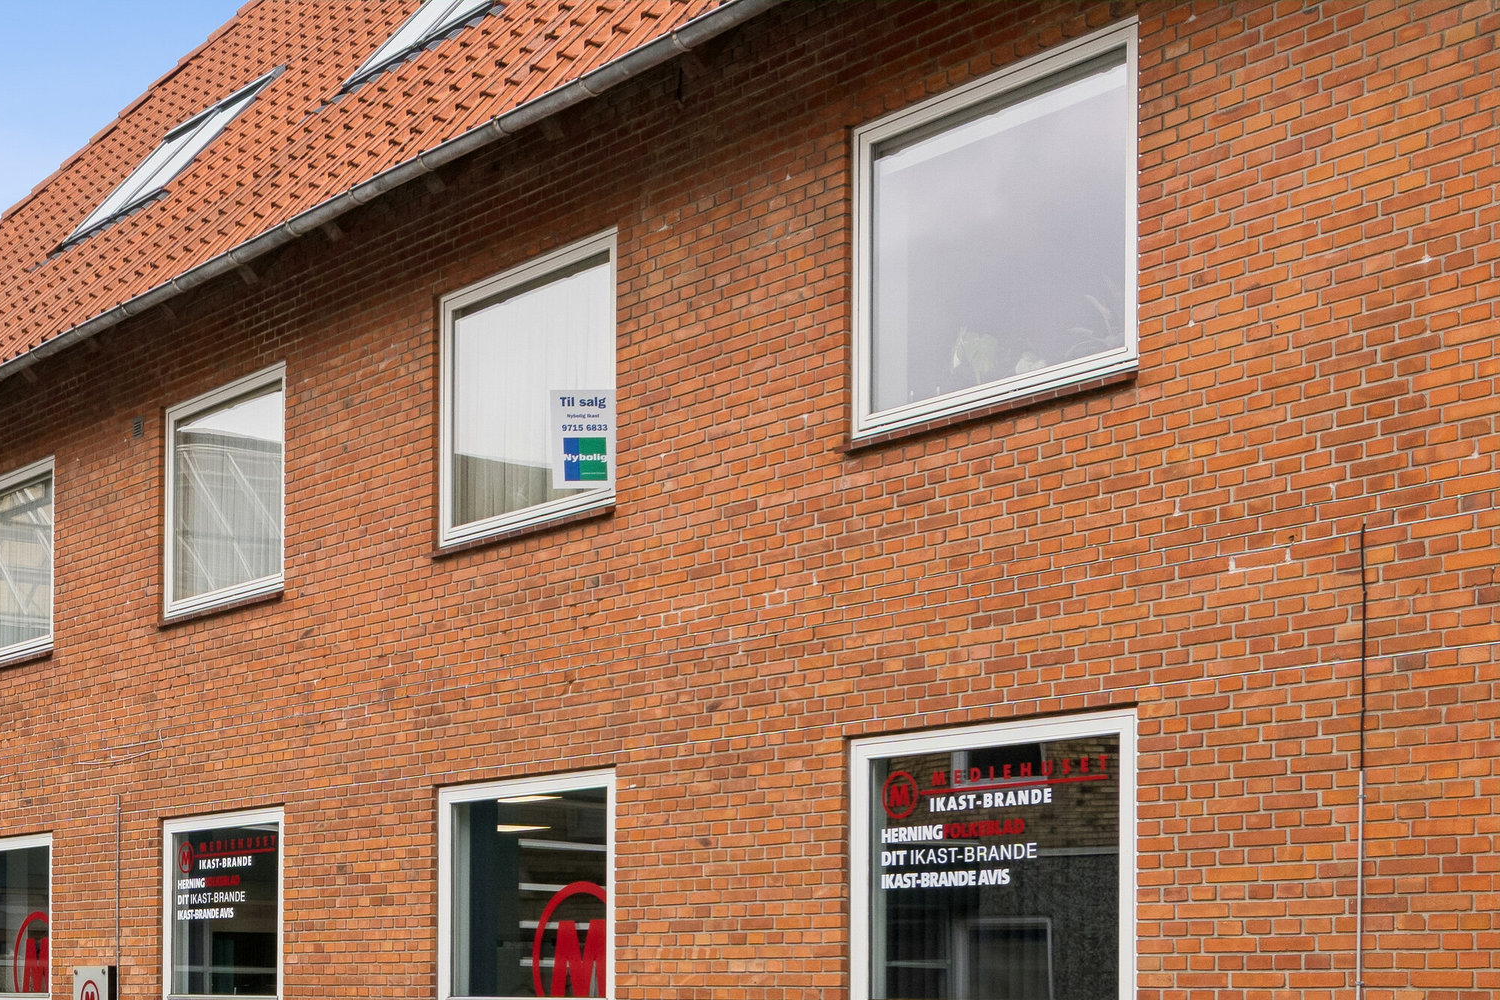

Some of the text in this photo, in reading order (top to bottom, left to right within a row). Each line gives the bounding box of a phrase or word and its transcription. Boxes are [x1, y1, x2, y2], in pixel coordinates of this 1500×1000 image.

[560, 397, 607, 409] Til salg
[564, 453, 607, 463] Nybolig
[931, 755, 1108, 786] MEDIEHUSET
[929, 788, 1052, 812] IKAST-BRANDE
[200, 835, 276, 852] MEDIEHUSET
[881, 842, 1037, 866] DIT IKAST-BRANDE
[199, 856, 252, 870] IKAST-BRANDE
[881, 869, 1011, 889] IKAST-BRANDE AVIS
[178, 891, 245, 905] DIT IKAST-BRANDE
[178, 907, 234, 920] IKAST-BRANDE AVIS
